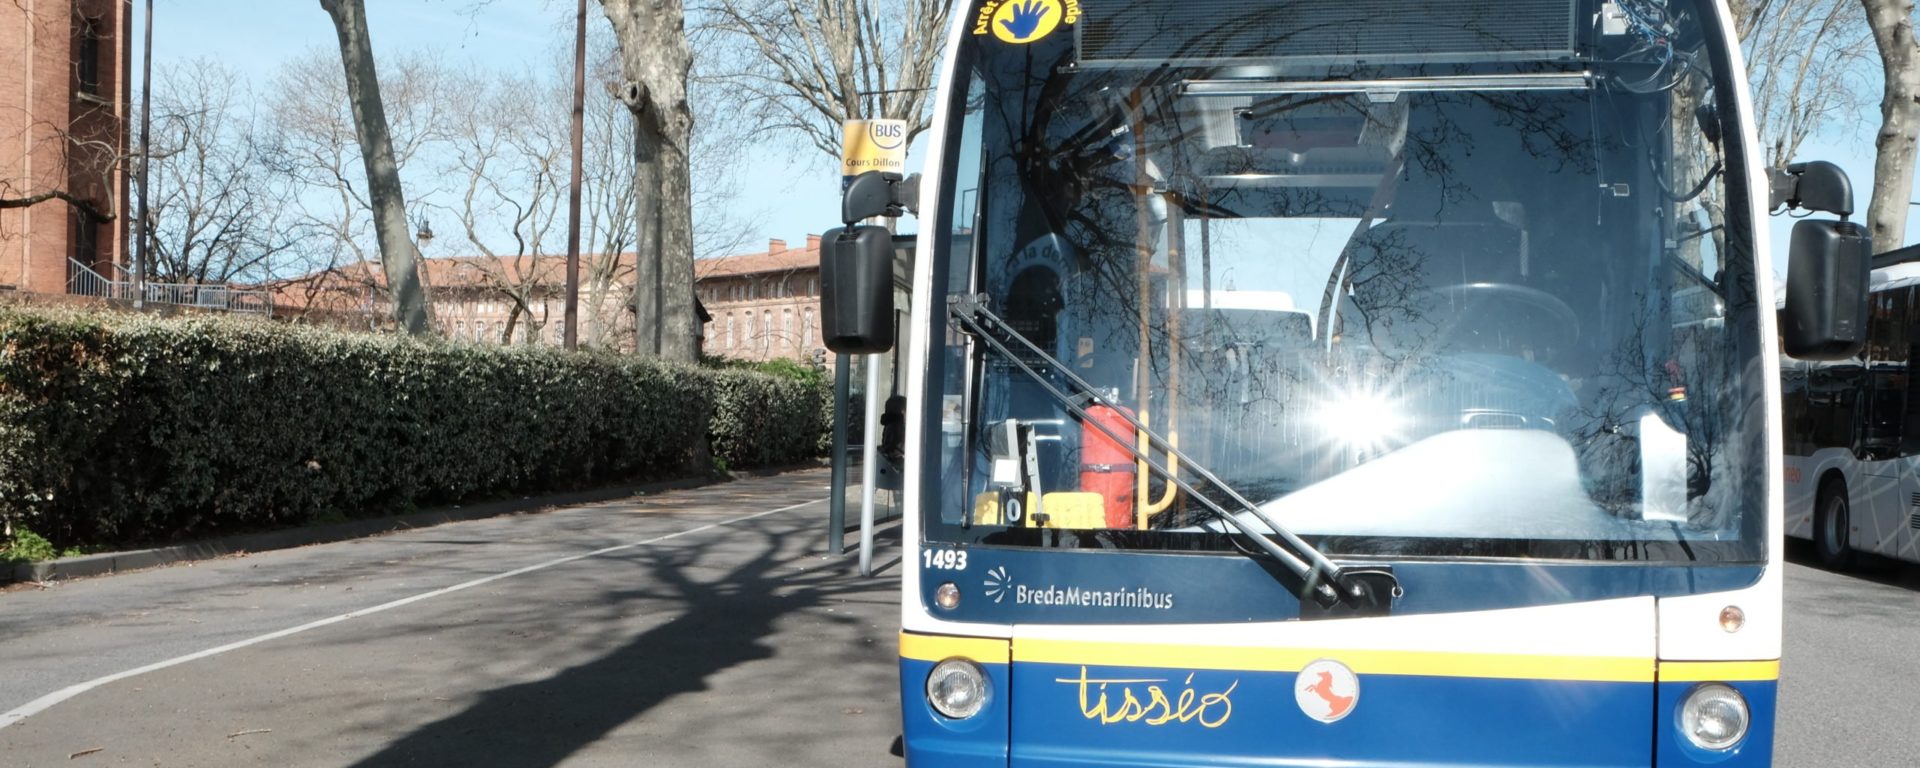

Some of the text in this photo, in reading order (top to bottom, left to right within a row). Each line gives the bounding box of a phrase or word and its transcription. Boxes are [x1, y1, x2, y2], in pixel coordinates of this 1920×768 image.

[973, 1, 999, 35] Arrêt
[1064, 0, 1082, 25] nde
[875, 124, 902, 138] BUS
[845, 158, 901, 168] Cours Dillon
[923, 549, 968, 571] 1493
[1016, 584, 1174, 610] BredaMenarinibus
[1055, 664, 1239, 728] tisséo
